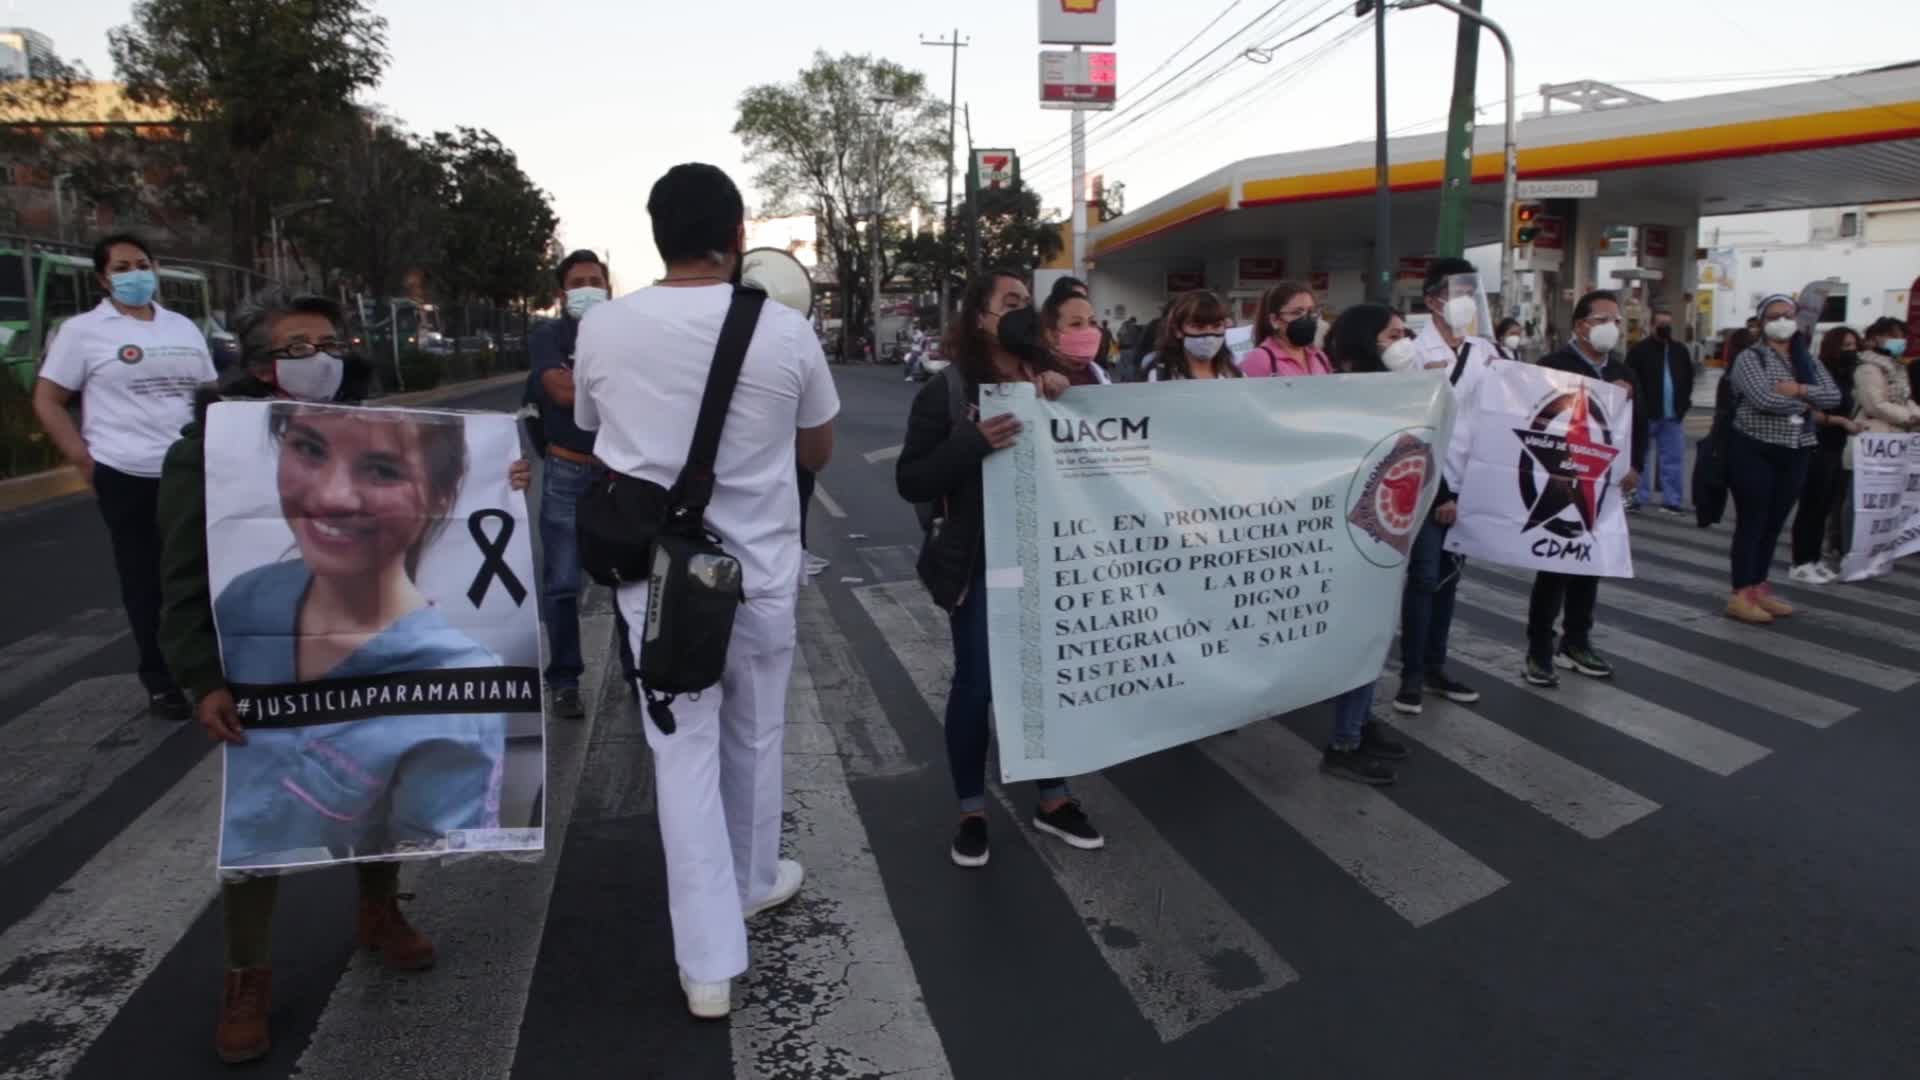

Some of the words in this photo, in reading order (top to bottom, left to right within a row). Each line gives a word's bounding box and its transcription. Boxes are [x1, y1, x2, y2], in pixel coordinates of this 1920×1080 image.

[1050, 416, 1151, 443] UACM
[1053, 518, 1096, 538] LIC.
[1112, 512, 1147, 531] EN
[1163, 496, 1297, 528] PROMOCIÓN
[1311, 494, 1336, 512] DE
[1054, 544, 1087, 562] LA
[1093, 536, 1169, 558] SALUD
[1180, 531, 1209, 549] EN
[1218, 522, 1289, 544] LUCHA
[1296, 515, 1335, 534] POR
[1531, 537, 1592, 562] CDMX
[1055, 568, 1089, 587] EL
[1092, 557, 1182, 583] CÓDIGO
[1054, 582, 1167, 612] OFERTA
[1055, 605, 1159, 636] SALARIO
[1233, 584, 1301, 609] DIGNO
[1320, 578, 1333, 594] E
[1057, 616, 1212, 661] INTEGRACIÓN
[1224, 613, 1256, 632] AL
[1266, 599, 1330, 625] NUEVO
[1056, 651, 1177, 685] SISTEMA
[1200, 638, 1230, 658] DE
[1257, 620, 1328, 648] SALUD
[236, 680, 532, 720] #JUSTICIAPARAMARIANA
[1058, 672, 1185, 709] NACIONAL.
